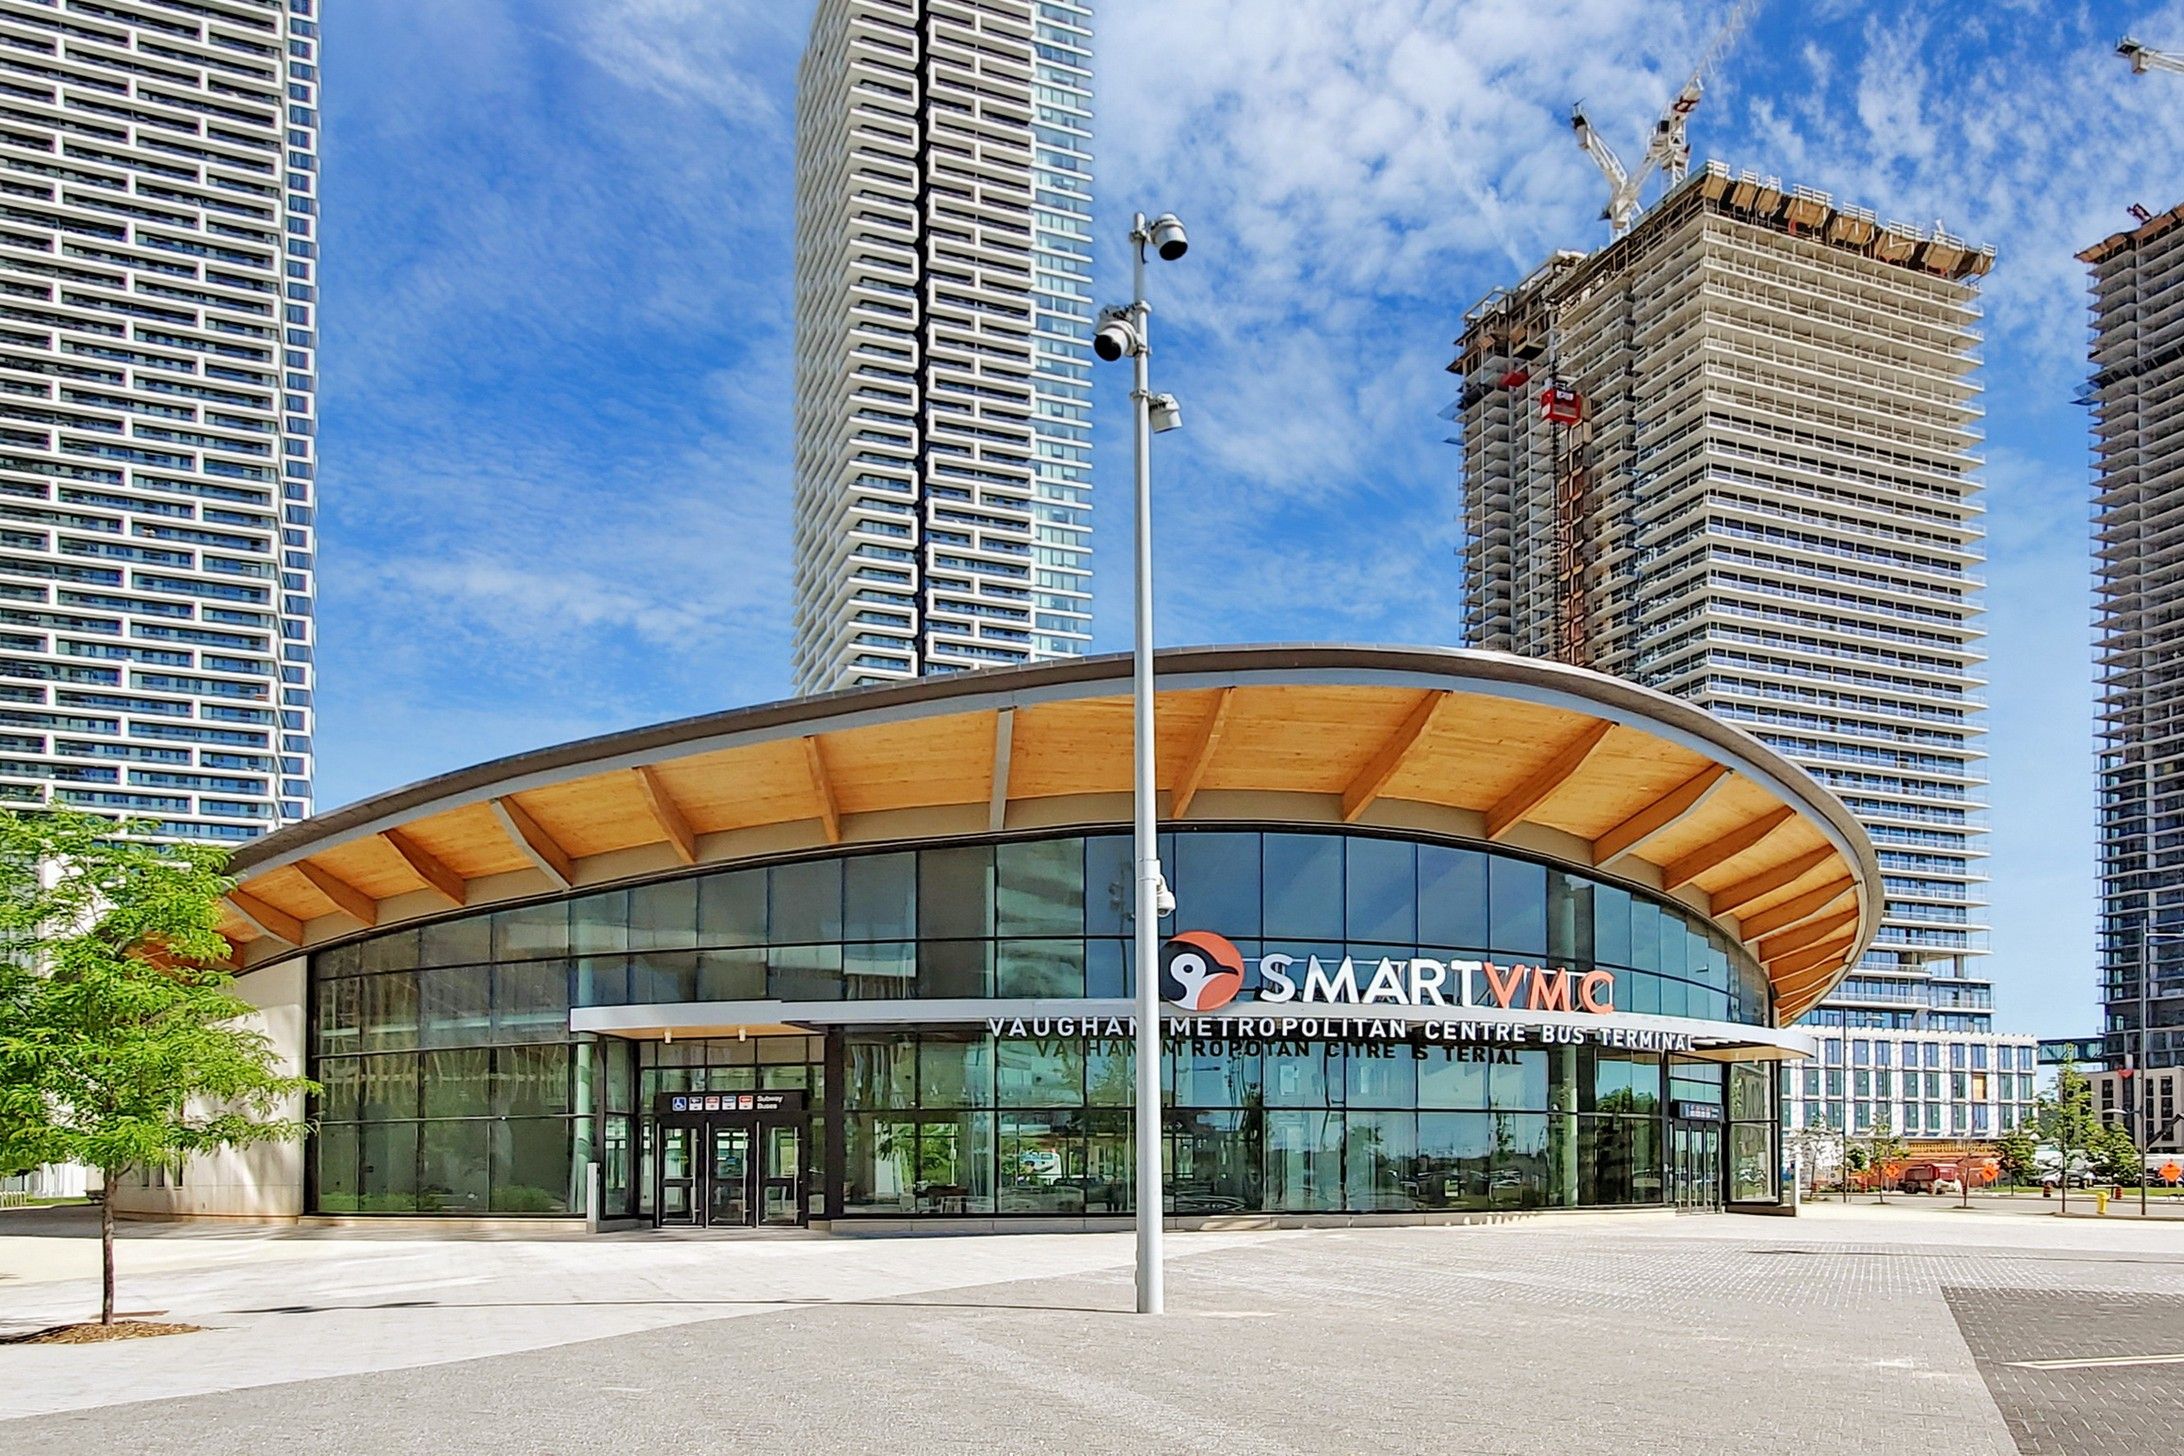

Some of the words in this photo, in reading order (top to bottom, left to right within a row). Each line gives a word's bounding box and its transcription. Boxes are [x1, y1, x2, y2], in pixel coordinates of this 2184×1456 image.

[1169, 1016, 1407, 1039] METROPOLITAN
[1424, 1020, 1527, 1042] CENTRE
[1541, 1024, 1586, 1045] BUS
[1599, 1028, 1697, 1052] TERMINAL
